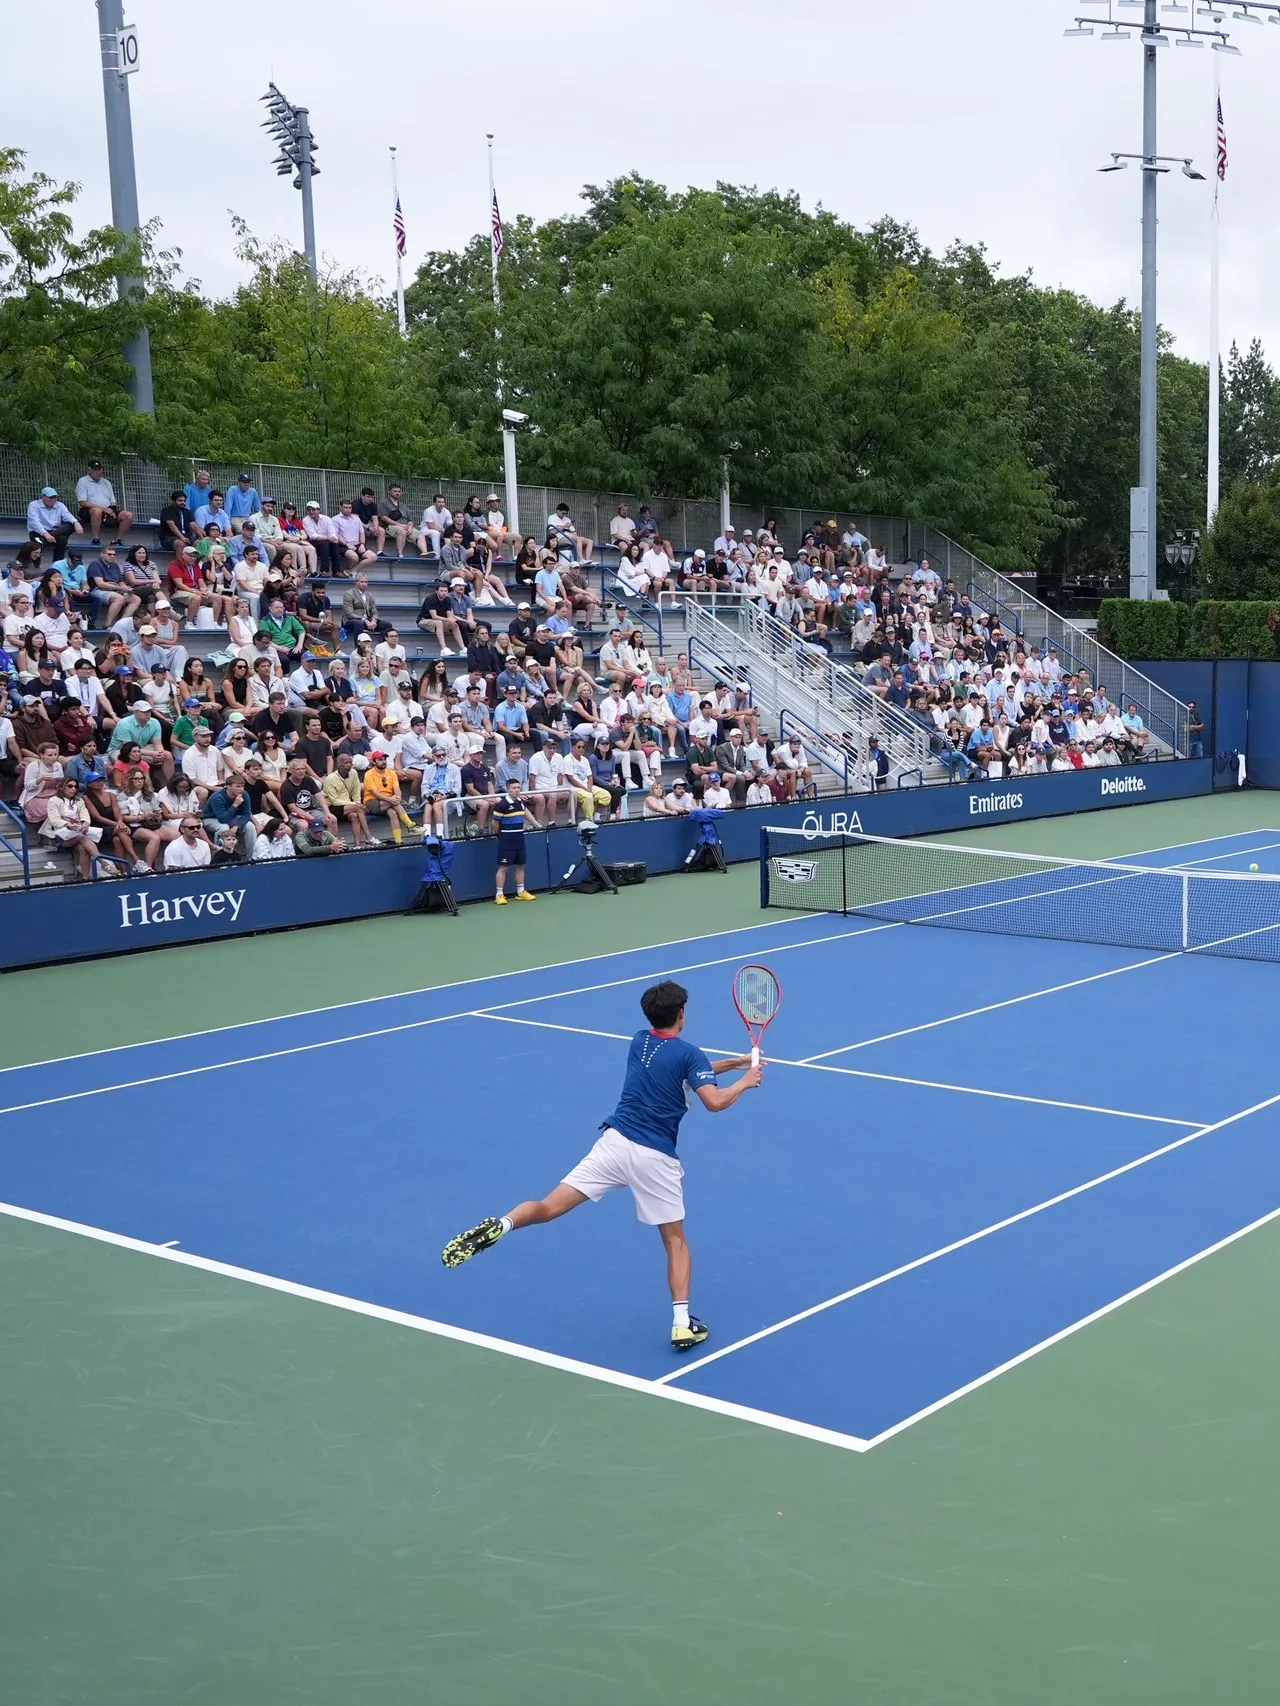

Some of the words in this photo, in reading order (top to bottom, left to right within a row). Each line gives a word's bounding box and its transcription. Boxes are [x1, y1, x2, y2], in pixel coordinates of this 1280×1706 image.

[120, 35, 138, 65] 10
[1101, 776, 1146, 795] Deloitte.
[969, 792, 1023, 815] Emirates
[118, 889, 247, 928] Harvey
